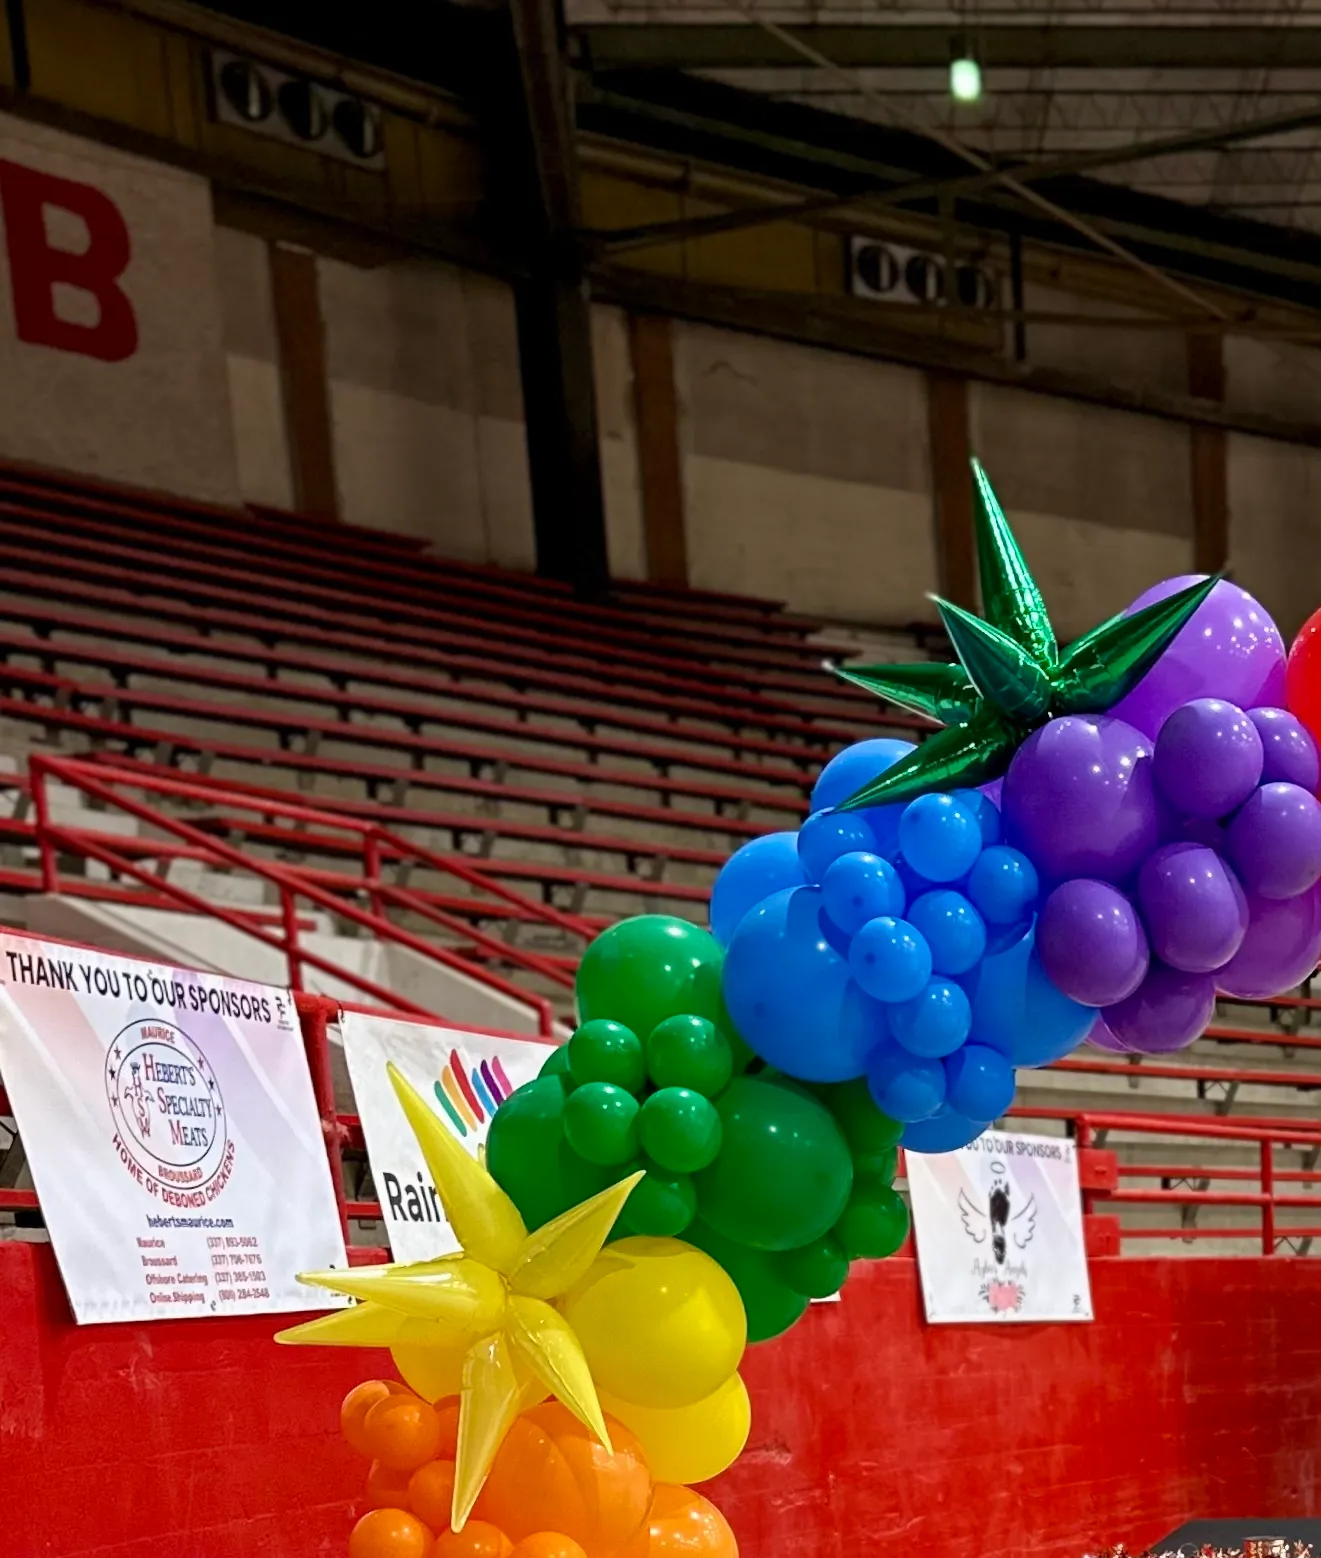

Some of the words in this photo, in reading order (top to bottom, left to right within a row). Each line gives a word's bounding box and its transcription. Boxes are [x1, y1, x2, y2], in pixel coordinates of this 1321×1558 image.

[0, 158, 139, 362] B
[7, 951, 79, 991] THANK
[79, 964, 120, 998] YOU
[123, 973, 148, 1002] TO
[150, 978, 191, 1010] OUR
[190, 984, 272, 1023] SPONSORS
[157, 1086, 212, 1118] SPECIALTY
[168, 1119, 209, 1147] MEATS
[980, 1138, 993, 1153] TO
[995, 1138, 1014, 1155] OUR
[1016, 1140, 1062, 1160] SPONSORS
[112, 1133, 143, 1185] HOME
[146, 1178, 159, 1197] OF
[162, 1187, 206, 1208] DEBONED
[205, 1139, 235, 1201] CHICKENS
[146, 1213, 235, 1228] hebertsmaurice.com
